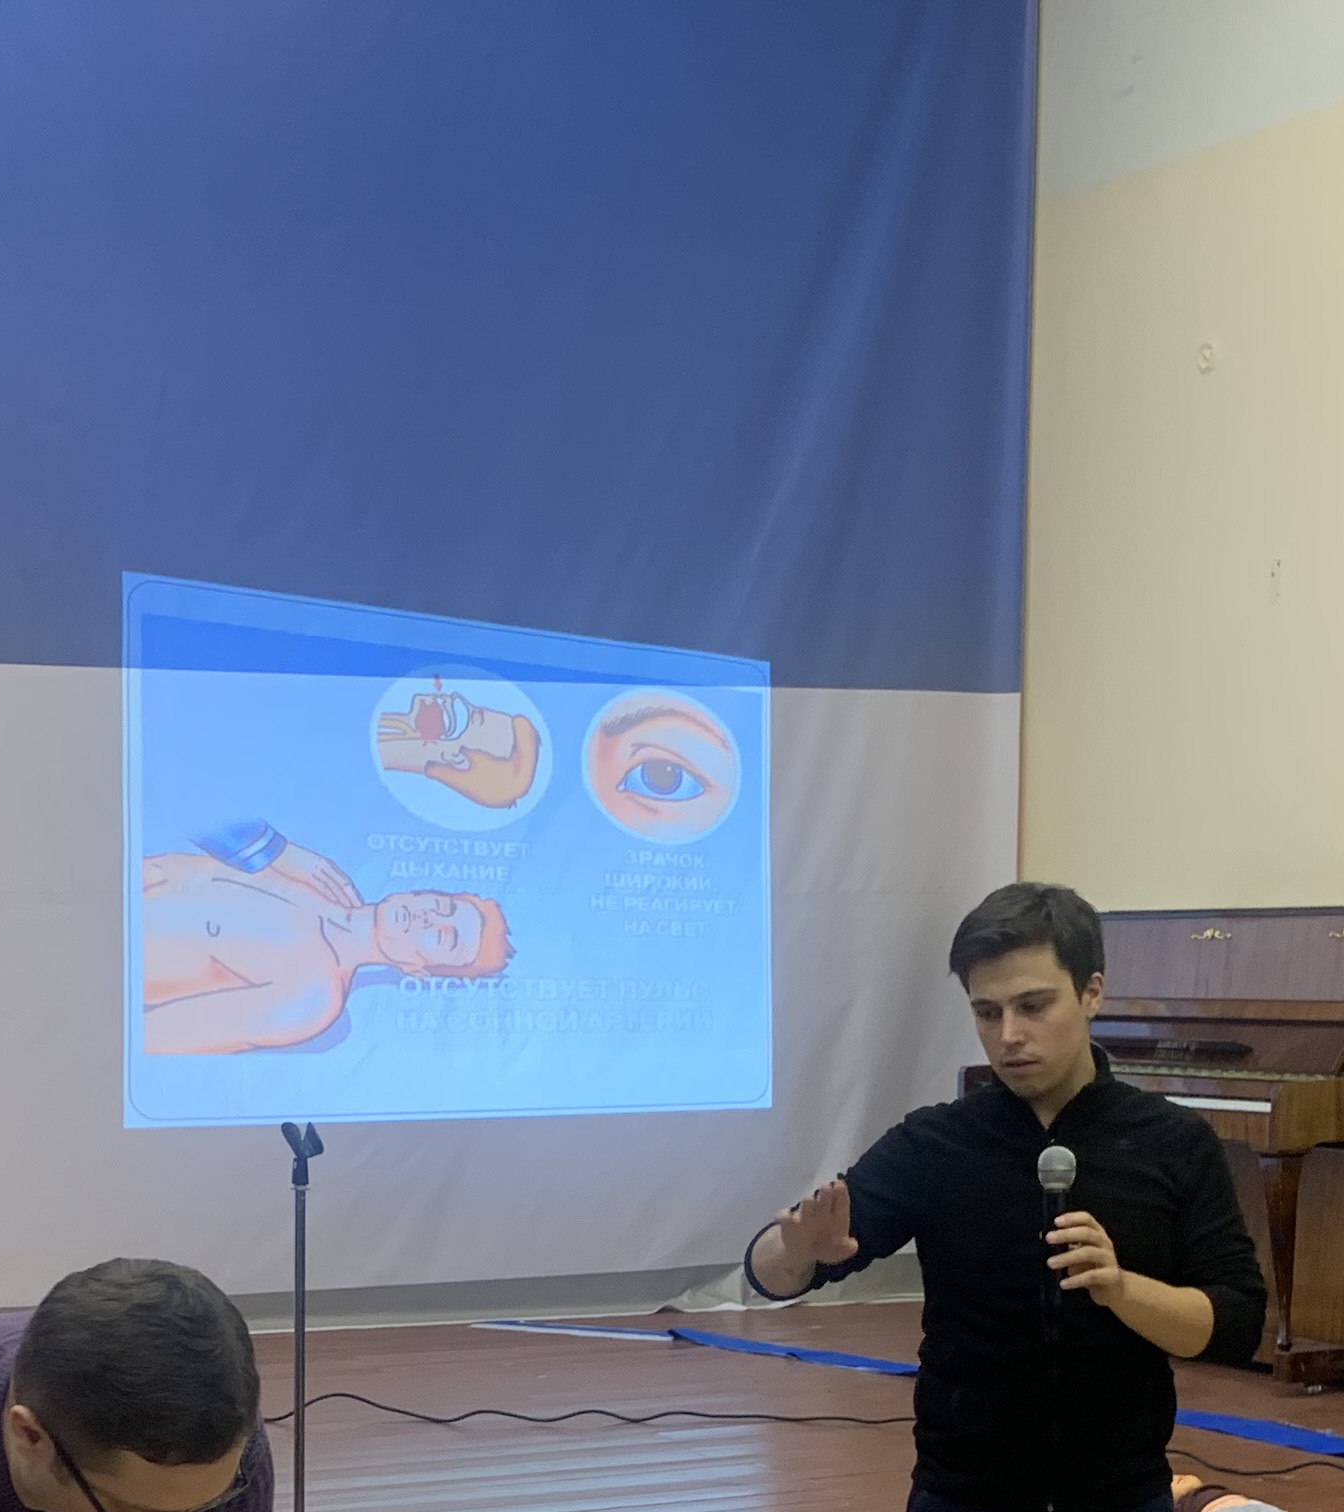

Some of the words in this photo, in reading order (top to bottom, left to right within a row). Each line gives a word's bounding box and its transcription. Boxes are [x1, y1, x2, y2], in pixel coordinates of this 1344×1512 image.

[367, 833, 530, 858] ОТСУТСТВУЕТ
[626, 850, 705, 868] ЗРАЧОК
[391, 860, 511, 882] ДЫХАНИЕ
[591, 895, 619, 911] НЕ
[624, 896, 736, 914] РЕАГИРУЕТ
[624, 919, 650, 936] НА
[656, 920, 707, 937] СВЕТ
[399, 976, 612, 1000] ОТСУТСТВУЕТ
[619, 978, 710, 1000] ПУЛЬС
[397, 1010, 438, 1032] НА
